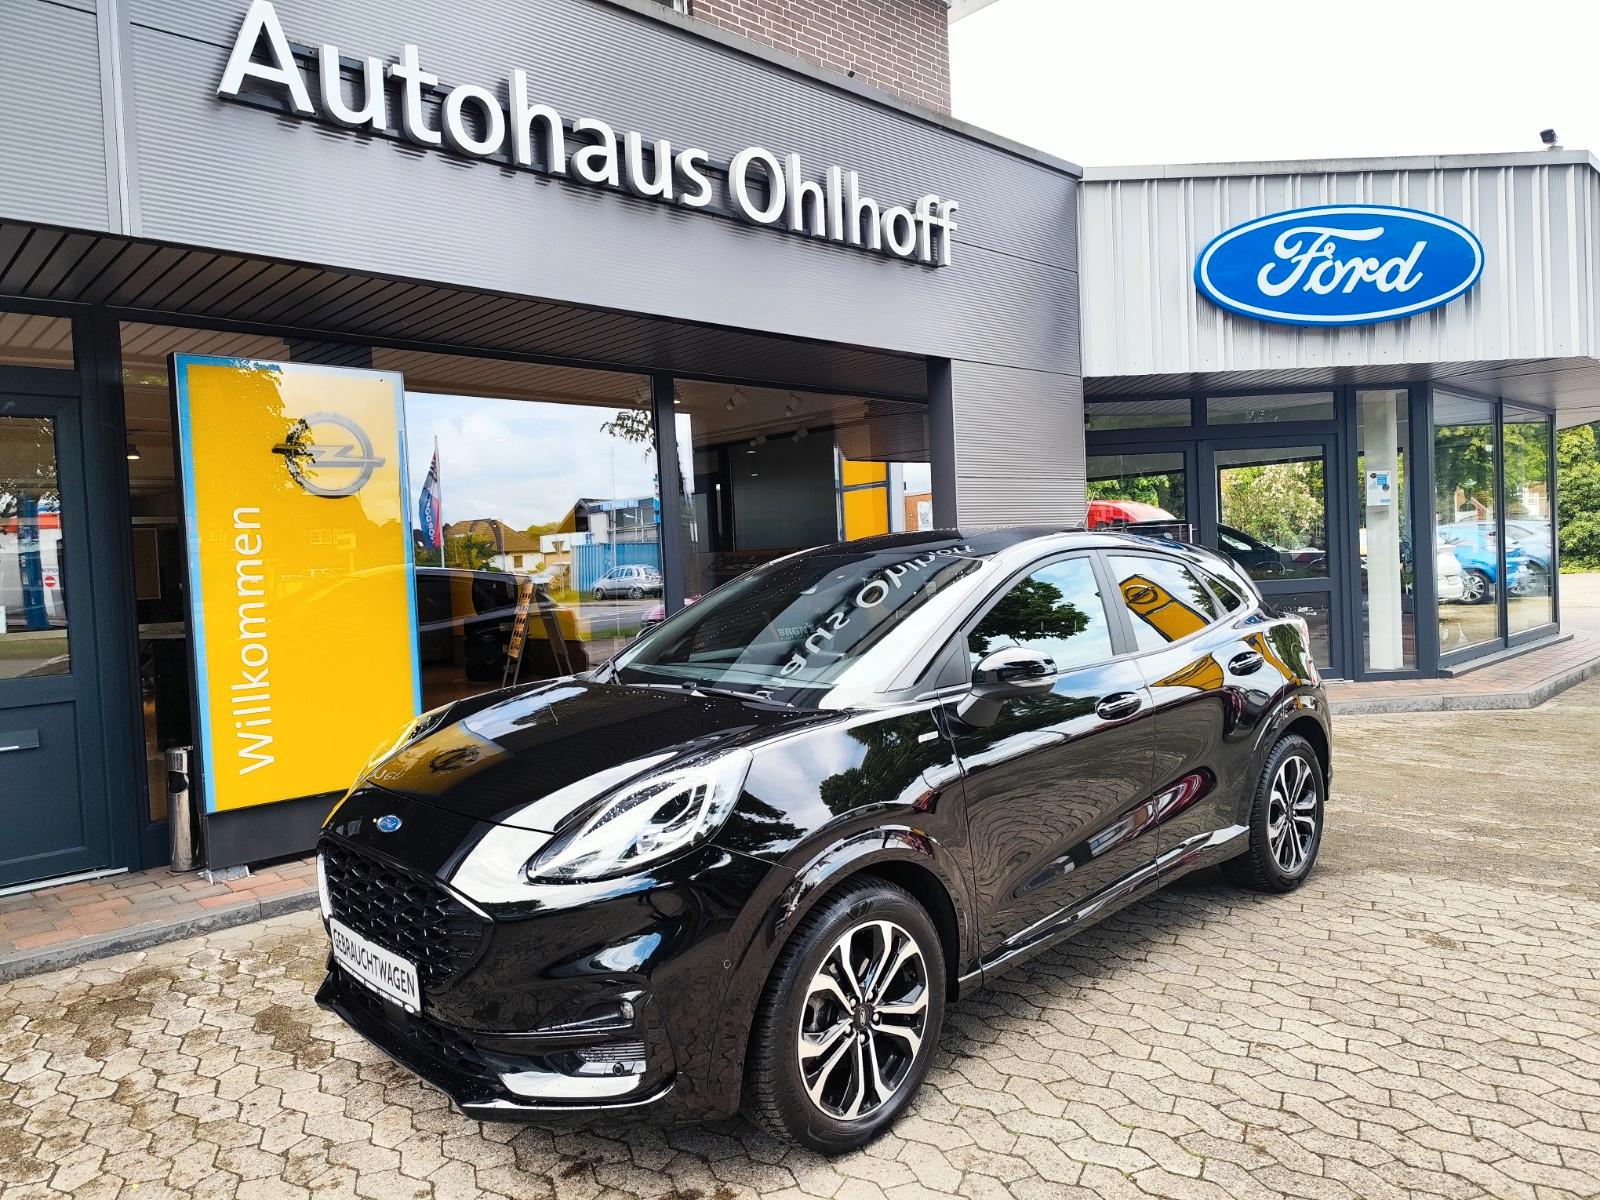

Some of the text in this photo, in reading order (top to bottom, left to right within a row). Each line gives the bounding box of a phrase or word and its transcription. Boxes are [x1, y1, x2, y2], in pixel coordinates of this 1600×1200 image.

[215, 0, 960, 267] Autohaus Ohlhoff
[1256, 226, 1428, 297] Ford
[230, 506, 276, 776] Willkommen
[333, 928, 416, 998] GEBRAUCHTWAGEN
